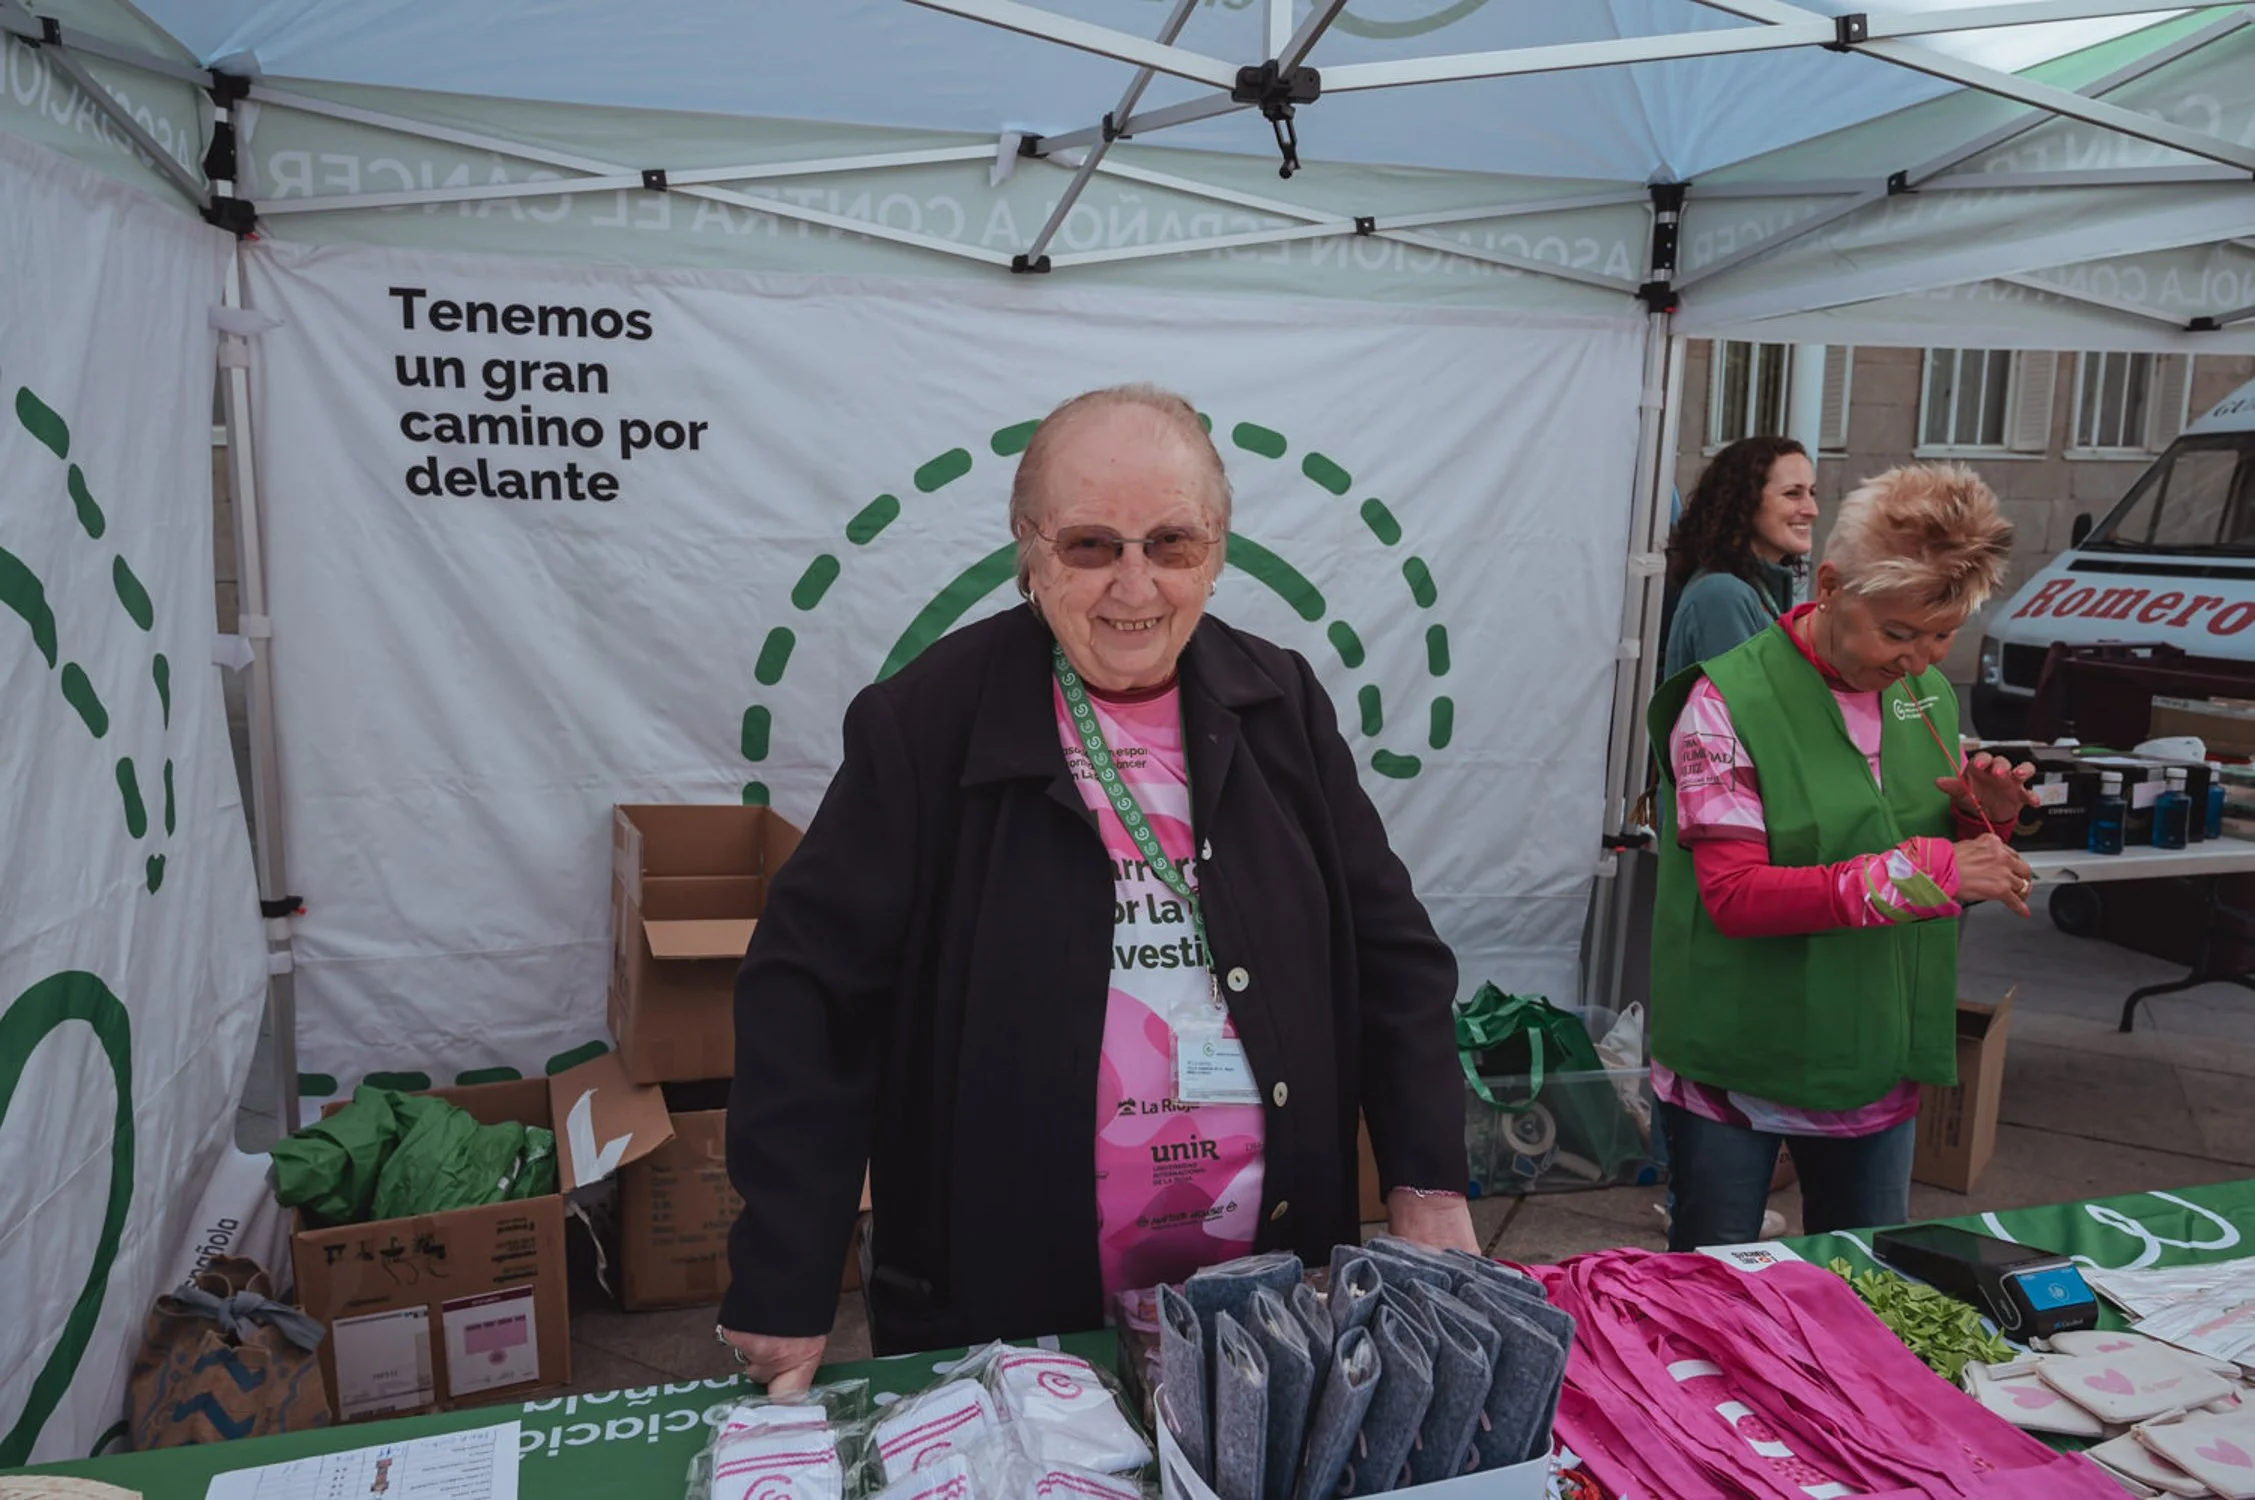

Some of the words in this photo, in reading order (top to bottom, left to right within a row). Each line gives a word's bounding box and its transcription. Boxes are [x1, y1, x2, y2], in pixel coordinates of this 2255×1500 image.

[388, 287, 653, 341] Tenemos
[395, 355, 466, 389] un
[482, 358, 608, 402] gran
[400, 405, 604, 448] camino
[620, 419, 708, 460] por
[405, 456, 620, 502] delante
[2010, 578, 2255, 636] Romero
[1145, 893, 1184, 925] la
[1141, 1101, 1159, 1114] La
